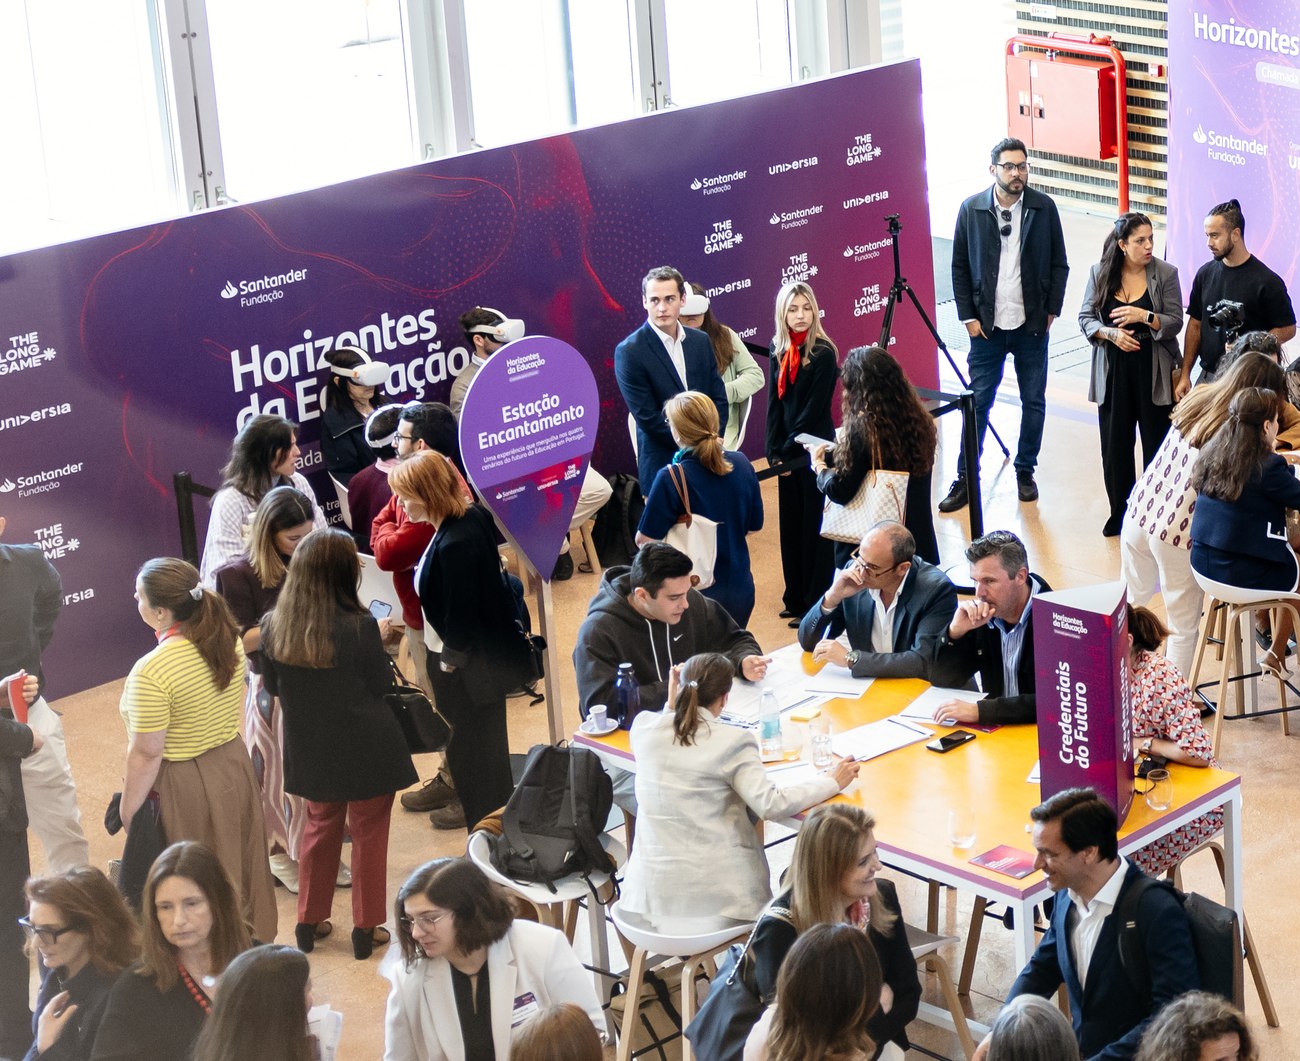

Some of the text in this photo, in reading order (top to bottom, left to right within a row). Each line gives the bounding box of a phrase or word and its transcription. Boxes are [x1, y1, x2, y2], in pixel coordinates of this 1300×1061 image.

[1193, 12, 1300, 57] Horizontes
[854, 133, 872, 145] THE
[1207, 130, 1268, 156] Santander
[847, 143, 872, 156] LONG
[1207, 148, 1246, 166] Fundação
[846, 153, 873, 167] GAME
[702, 169, 747, 188] Santander
[703, 183, 731, 196] Fundação
[780, 204, 823, 222] Santander
[713, 219, 732, 232] THE
[781, 217, 808, 231] Fundação
[705, 230, 732, 245] LONG
[854, 237, 893, 255] Santander
[704, 241, 733, 255] GAME
[854, 250, 880, 263] Fundação
[790, 252, 808, 265] THE
[782, 262, 809, 277] LONG
[239, 268, 308, 295] Santander
[781, 274, 809, 287] GAME
[240, 289, 284, 307] Fundação
[862, 284, 880, 296] THE
[854, 293, 880, 308] LONG
[853, 303, 881, 317] GAME
[9, 331, 39, 348] THE
[0, 357, 42, 376] GAME
[506, 352, 540, 367] Horizontes
[507, 358, 546, 375] da Educação
[296, 340, 470, 423] Eação
[502, 393, 560, 423] Estação
[478, 405, 585, 450] Encantamento
[483, 426, 584, 463] Uma experiência que mergulha nos quatro
[481, 460, 504, 471] cenários
[511, 453, 527, 462] futuro
[535, 443, 557, 455] Educação
[557, 439, 565, 447] em
[17, 462, 84, 489] Santander
[18, 481, 61, 498] Fundação
[502, 486, 526, 497] Santander
[34, 523, 63, 540] THE
[1052, 612, 1083, 626] Horizontes
[1053, 619, 1060, 627] da
[1061, 621, 1088, 634] Educação
[1055, 661, 1074, 764] Credenciais
[1074, 682, 1089, 769] do Futuro
